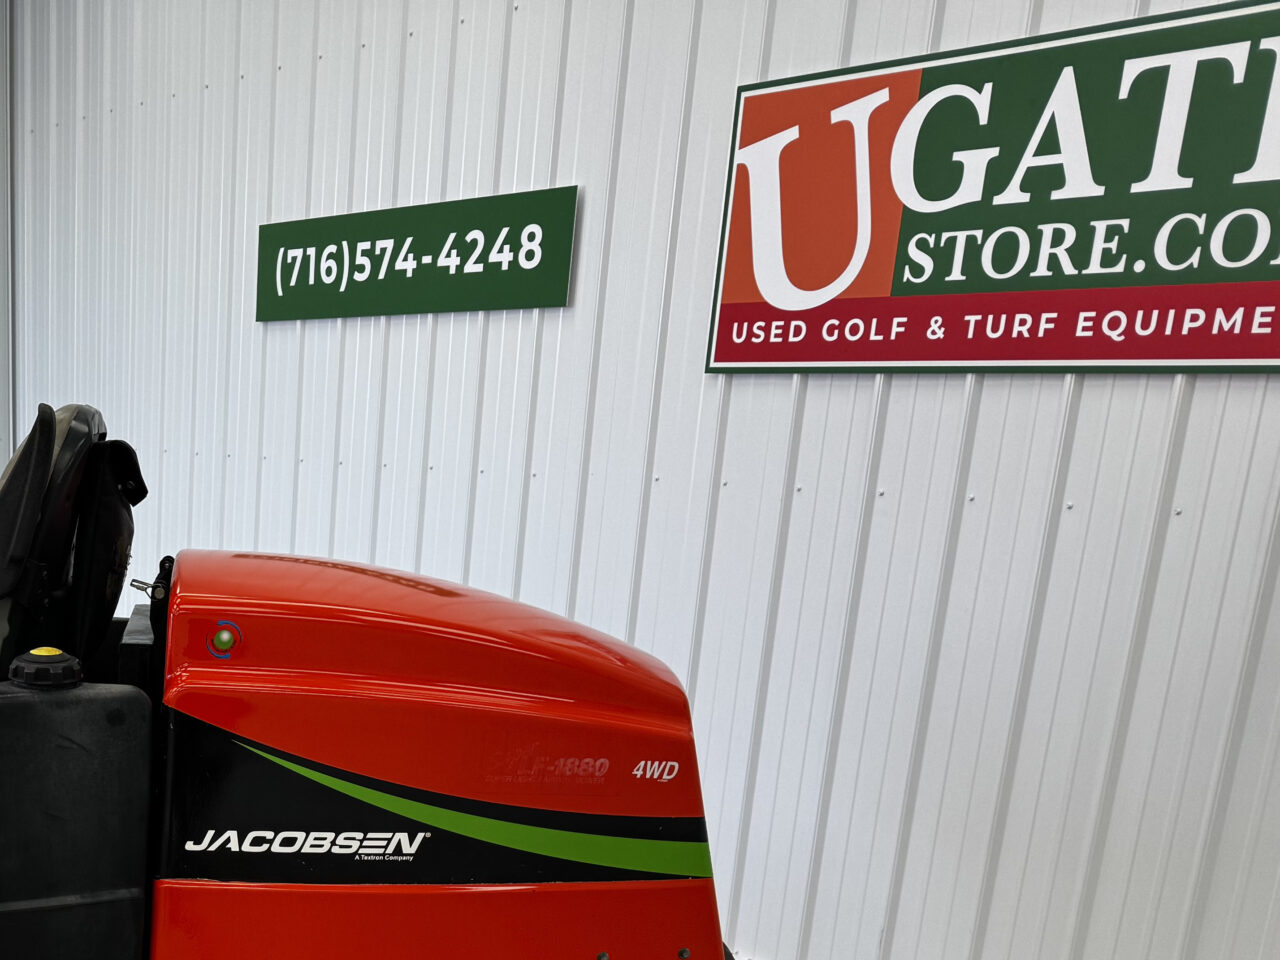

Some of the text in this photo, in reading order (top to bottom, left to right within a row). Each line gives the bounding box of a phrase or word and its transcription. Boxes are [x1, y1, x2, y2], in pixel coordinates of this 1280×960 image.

[275, 223, 543, 296] (716)574-4248
[902, 208, 1280, 283] STORE.CO
[731, 320, 807, 344] USED
[821, 316, 909, 342] GOLF
[926, 315, 946, 340] &
[964, 312, 1059, 339] TURF
[631, 760, 679, 780] 4WD
[184, 829, 426, 855] JACOBSEN
[384, 854, 414, 862] Company
